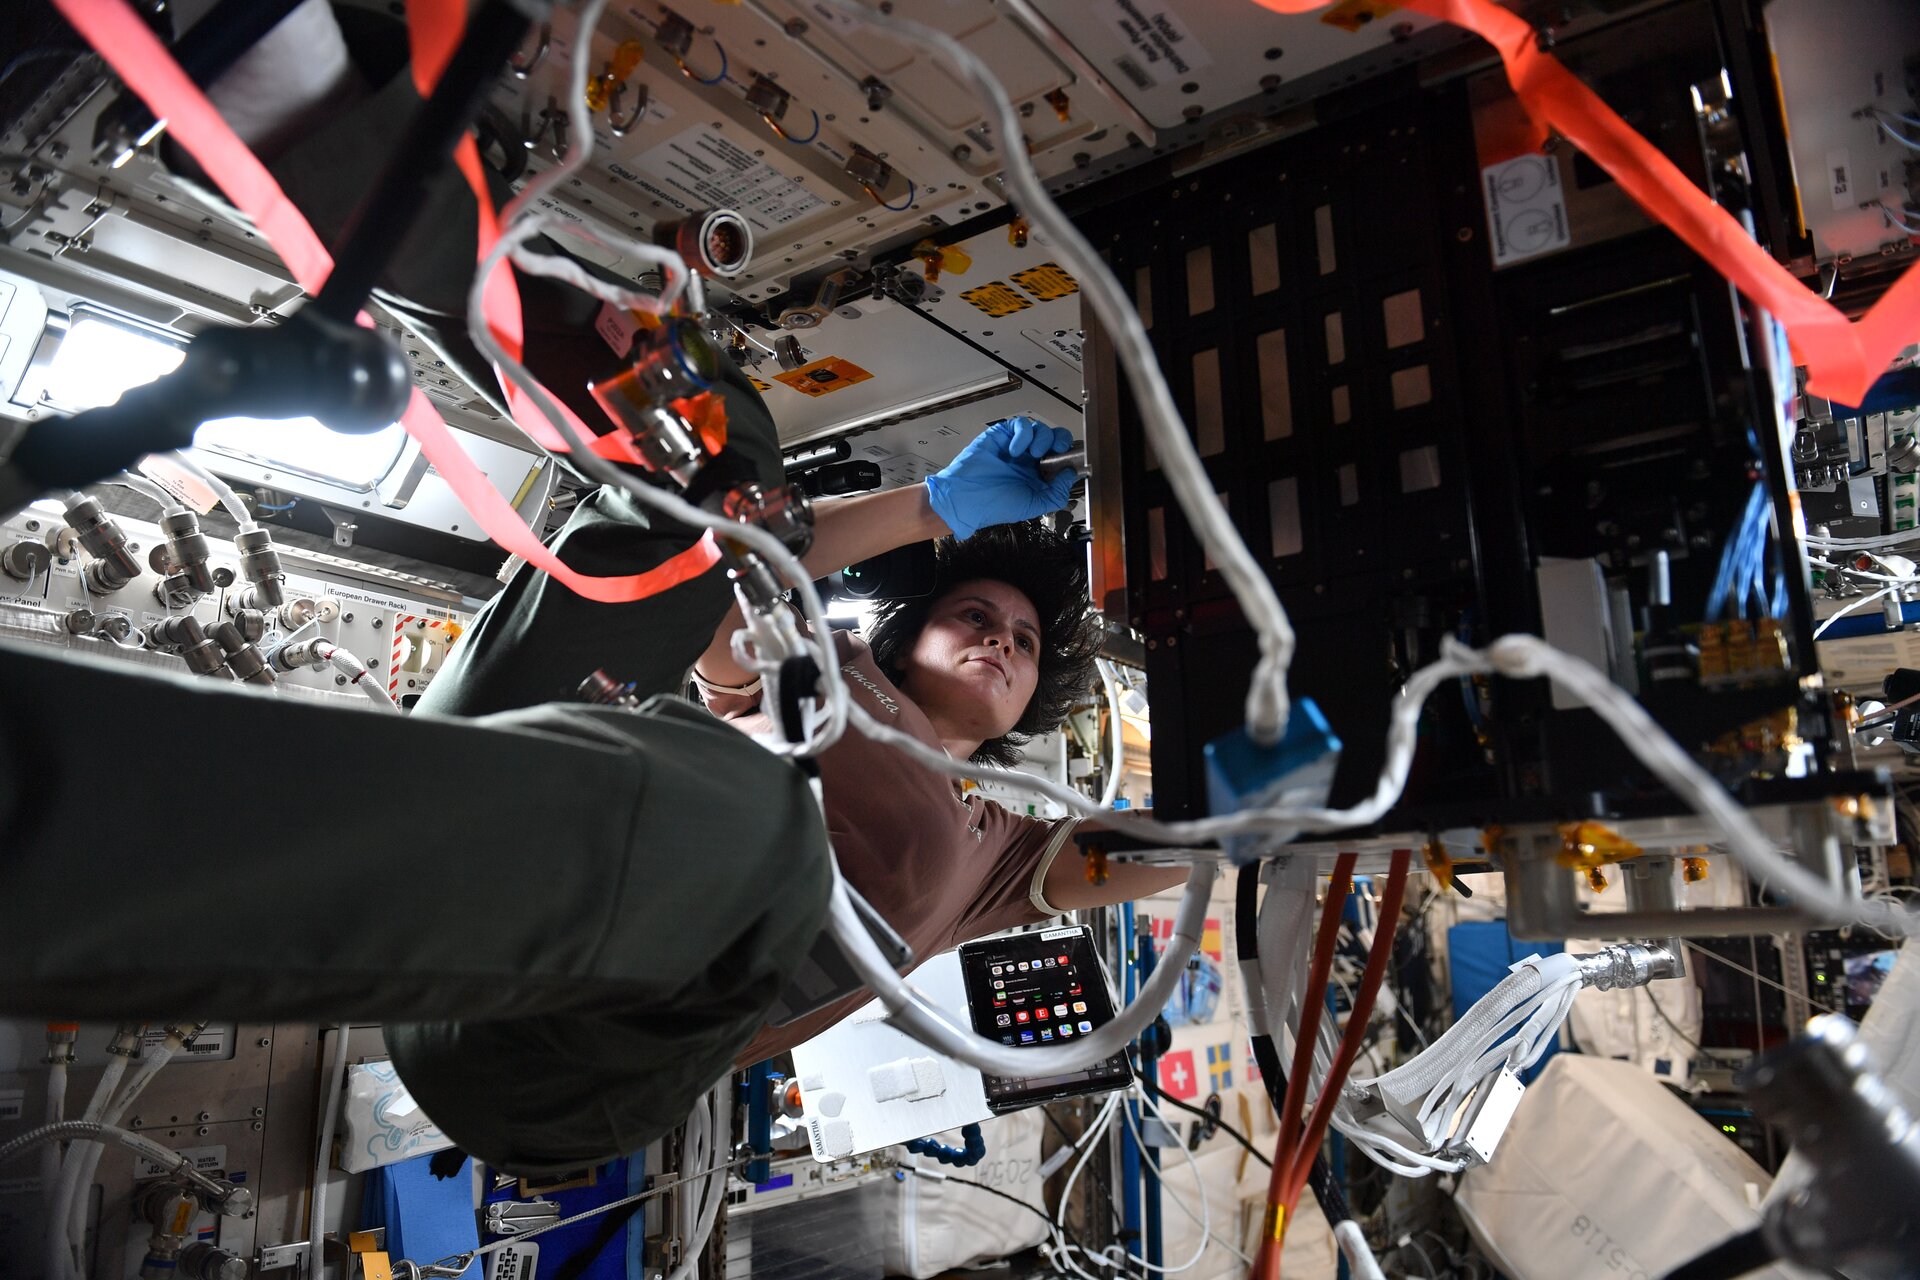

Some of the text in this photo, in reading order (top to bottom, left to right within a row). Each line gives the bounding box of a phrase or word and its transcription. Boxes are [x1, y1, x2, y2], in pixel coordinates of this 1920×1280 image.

[14, 598, 41, 608] Panel
[327, 588, 407, 611] (European Drawer Rack)
[1044, 930, 1078, 939] SAMANTHA
[811, 1120, 824, 1156] SAMANTHA
[196, 1161, 219, 1169] RETURN
